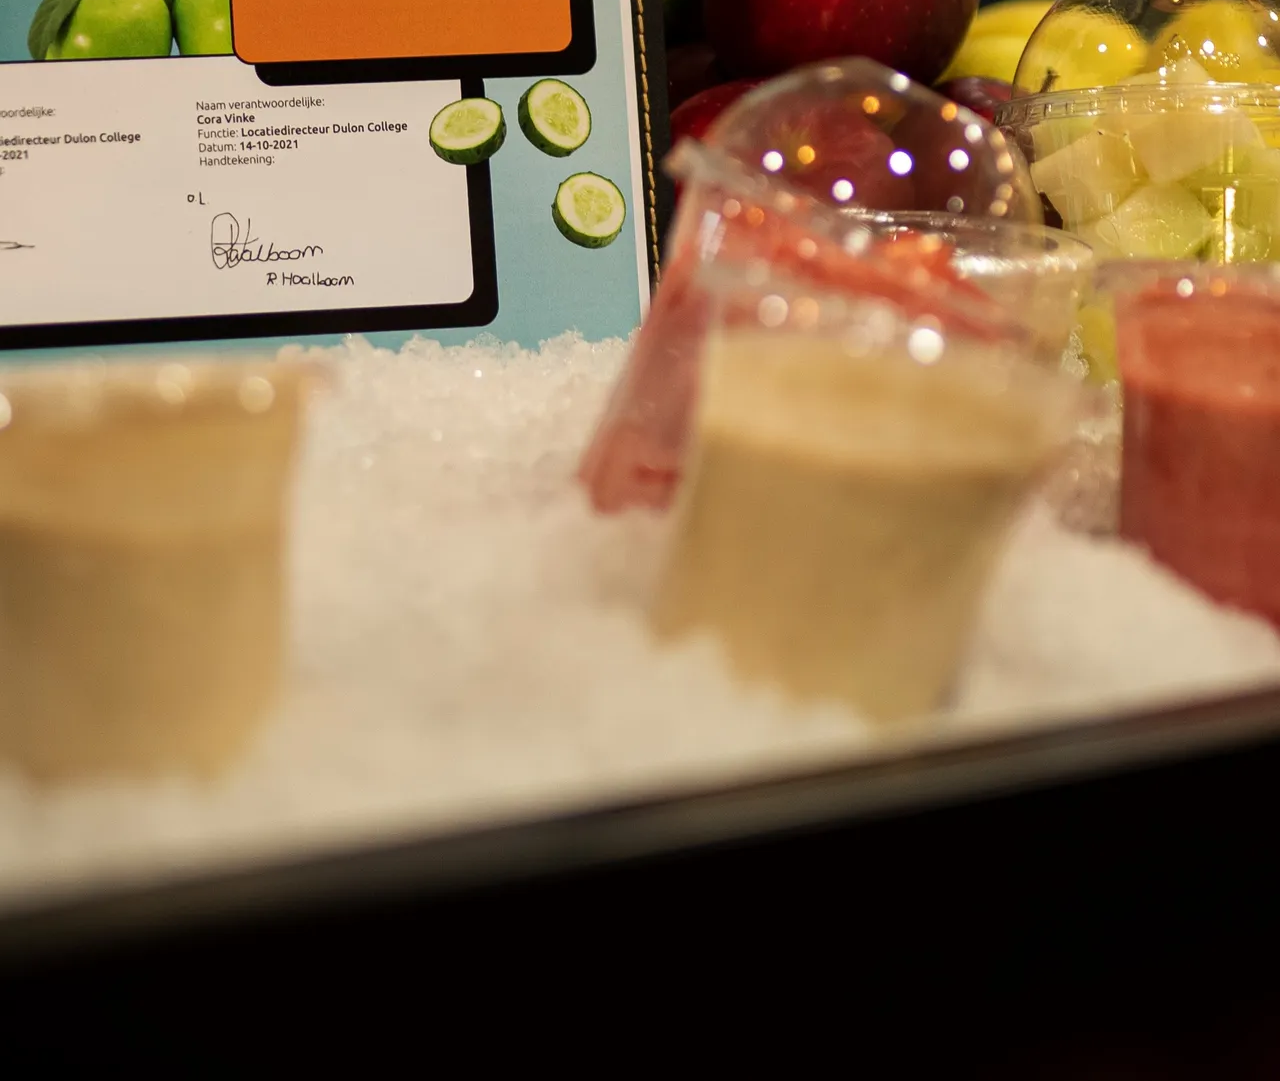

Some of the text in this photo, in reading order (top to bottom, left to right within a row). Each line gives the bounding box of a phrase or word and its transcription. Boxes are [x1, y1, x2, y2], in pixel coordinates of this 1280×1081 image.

[196, 97, 325, 110] Naam verantwoordelijke:
[197, 113, 255, 124] Cora Vinke
[198, 122, 408, 139] Functie: Locatiedirecteur Dulon College
[64, 133, 96, 144] Dulon
[99, 132, 141, 143] College
[198, 140, 298, 152] Datum: 14-10-2021
[200, 155, 275, 166] Handtekening:
